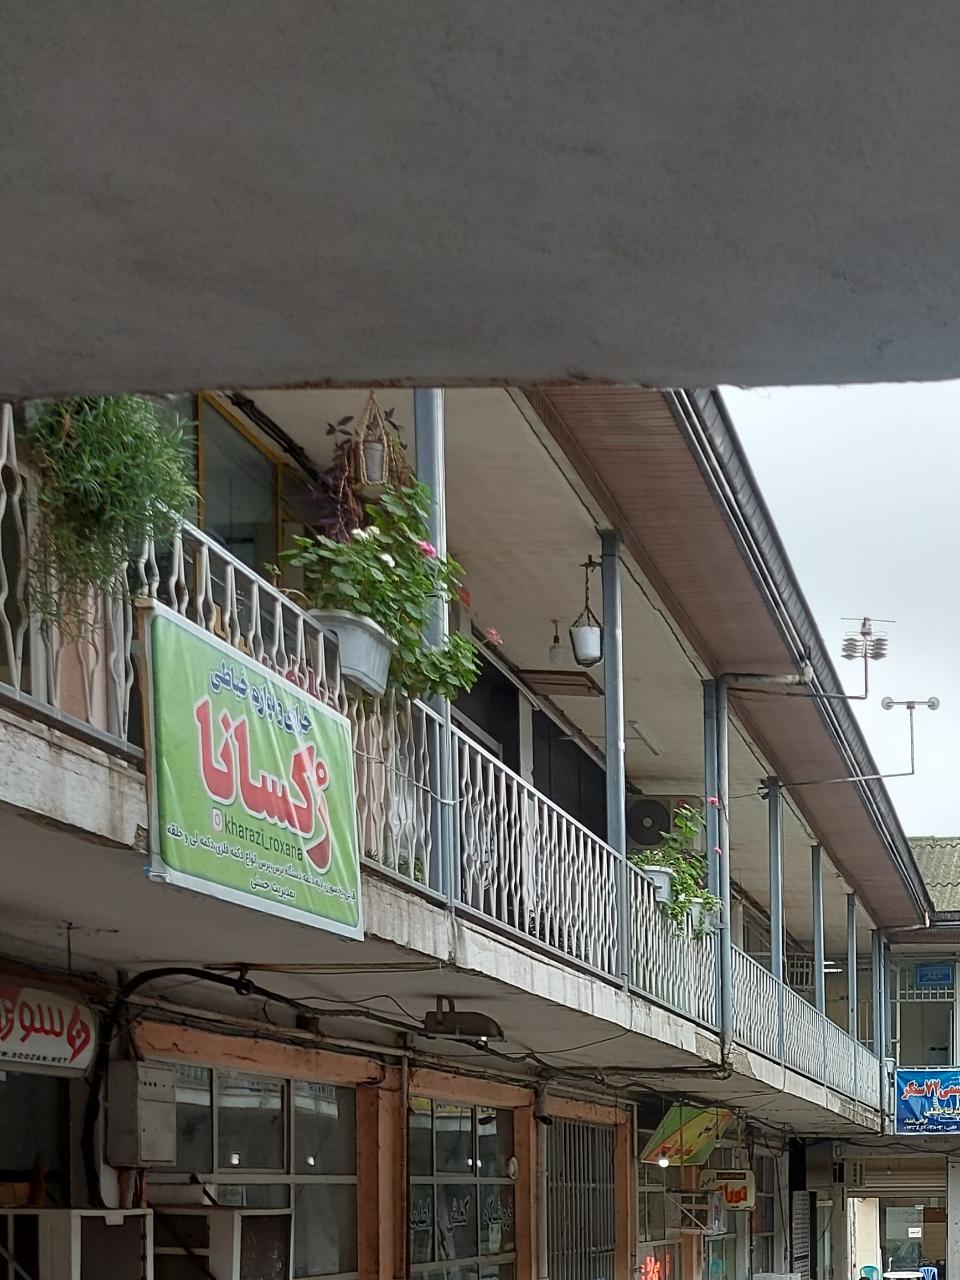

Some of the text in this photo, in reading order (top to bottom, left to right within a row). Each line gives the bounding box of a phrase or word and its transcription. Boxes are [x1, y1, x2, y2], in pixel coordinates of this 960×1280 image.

[209, 658, 250, 702] خیاطی
[224, 813, 304, 861] kharazi_roxana
[0, 1050, 68, 1063] W.SOOZAN.NET
